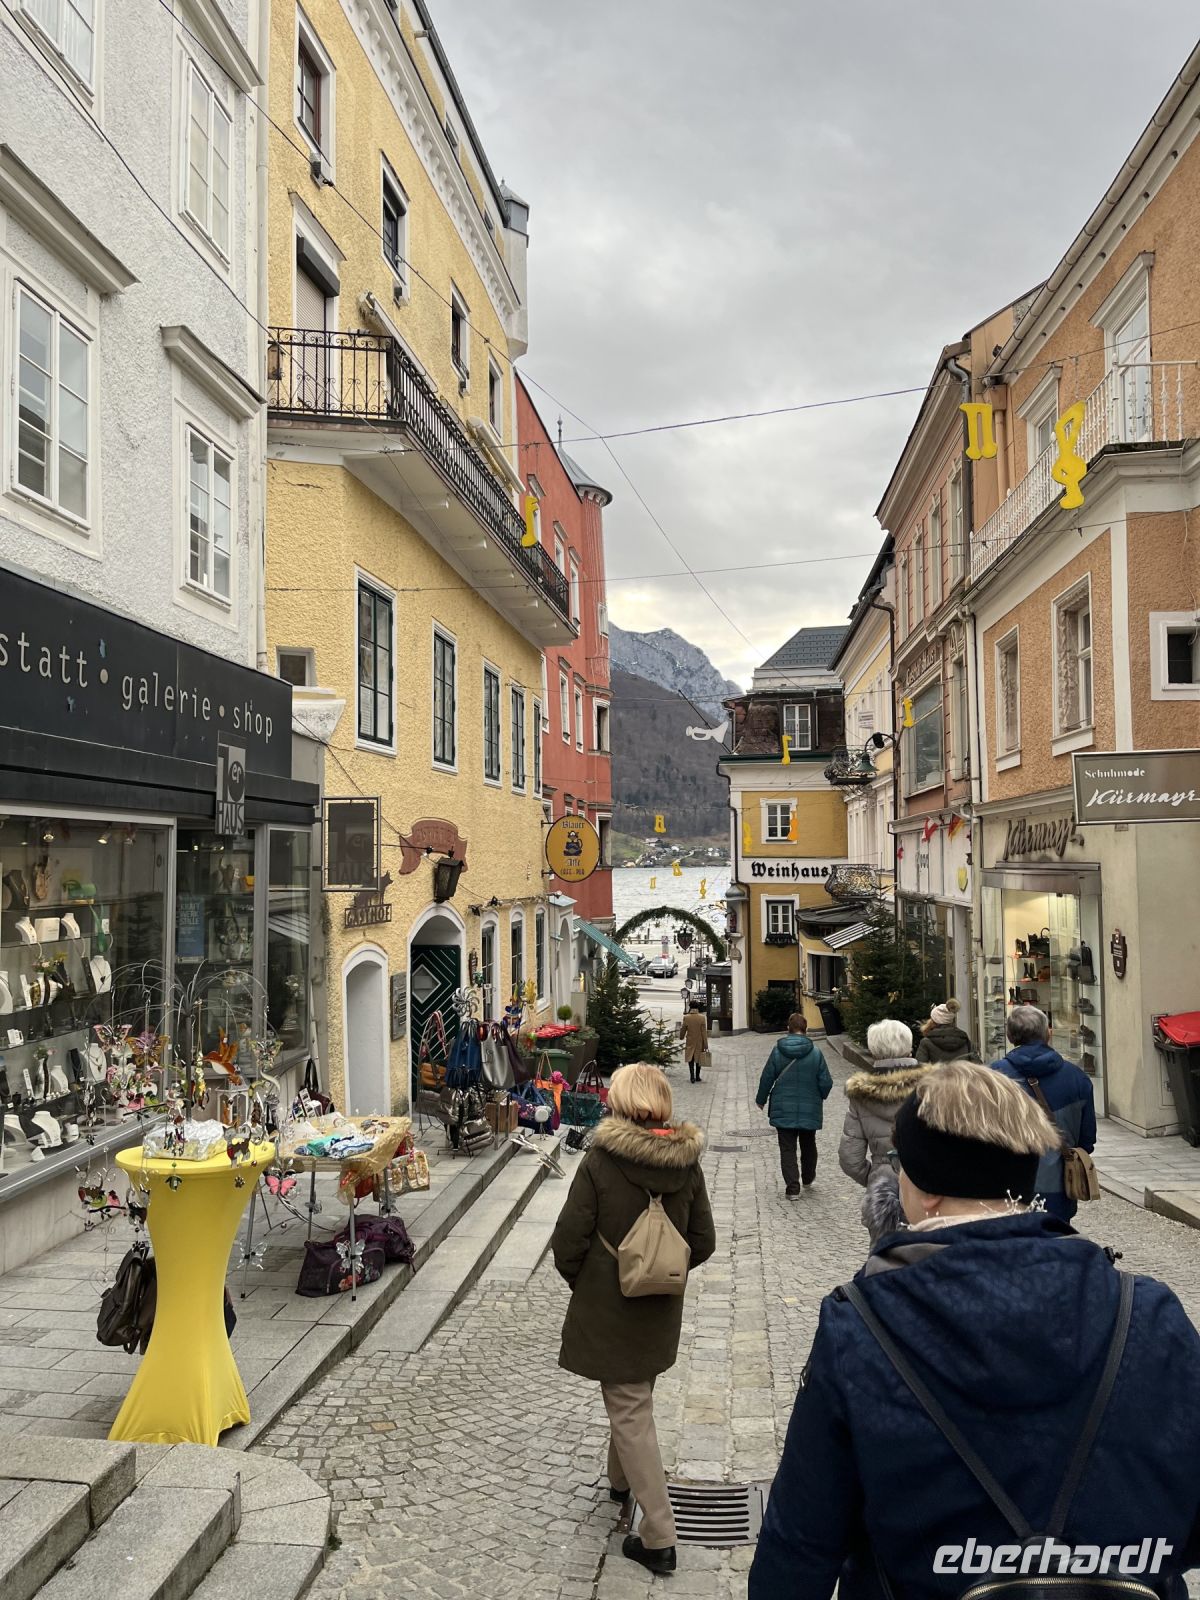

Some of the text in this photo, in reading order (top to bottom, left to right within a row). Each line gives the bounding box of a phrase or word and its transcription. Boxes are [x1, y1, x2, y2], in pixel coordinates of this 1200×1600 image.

[0, 631, 273, 744] statt galerie shop
[1084, 767, 1146, 779] Schuhmode
[1085, 788, 1200, 807] Kürmayr
[216, 801, 245, 835] HAUS
[562, 821, 585, 829] Blauer
[751, 861, 829, 881] Weinhaus
[346, 906, 390, 926] GASTHOF
